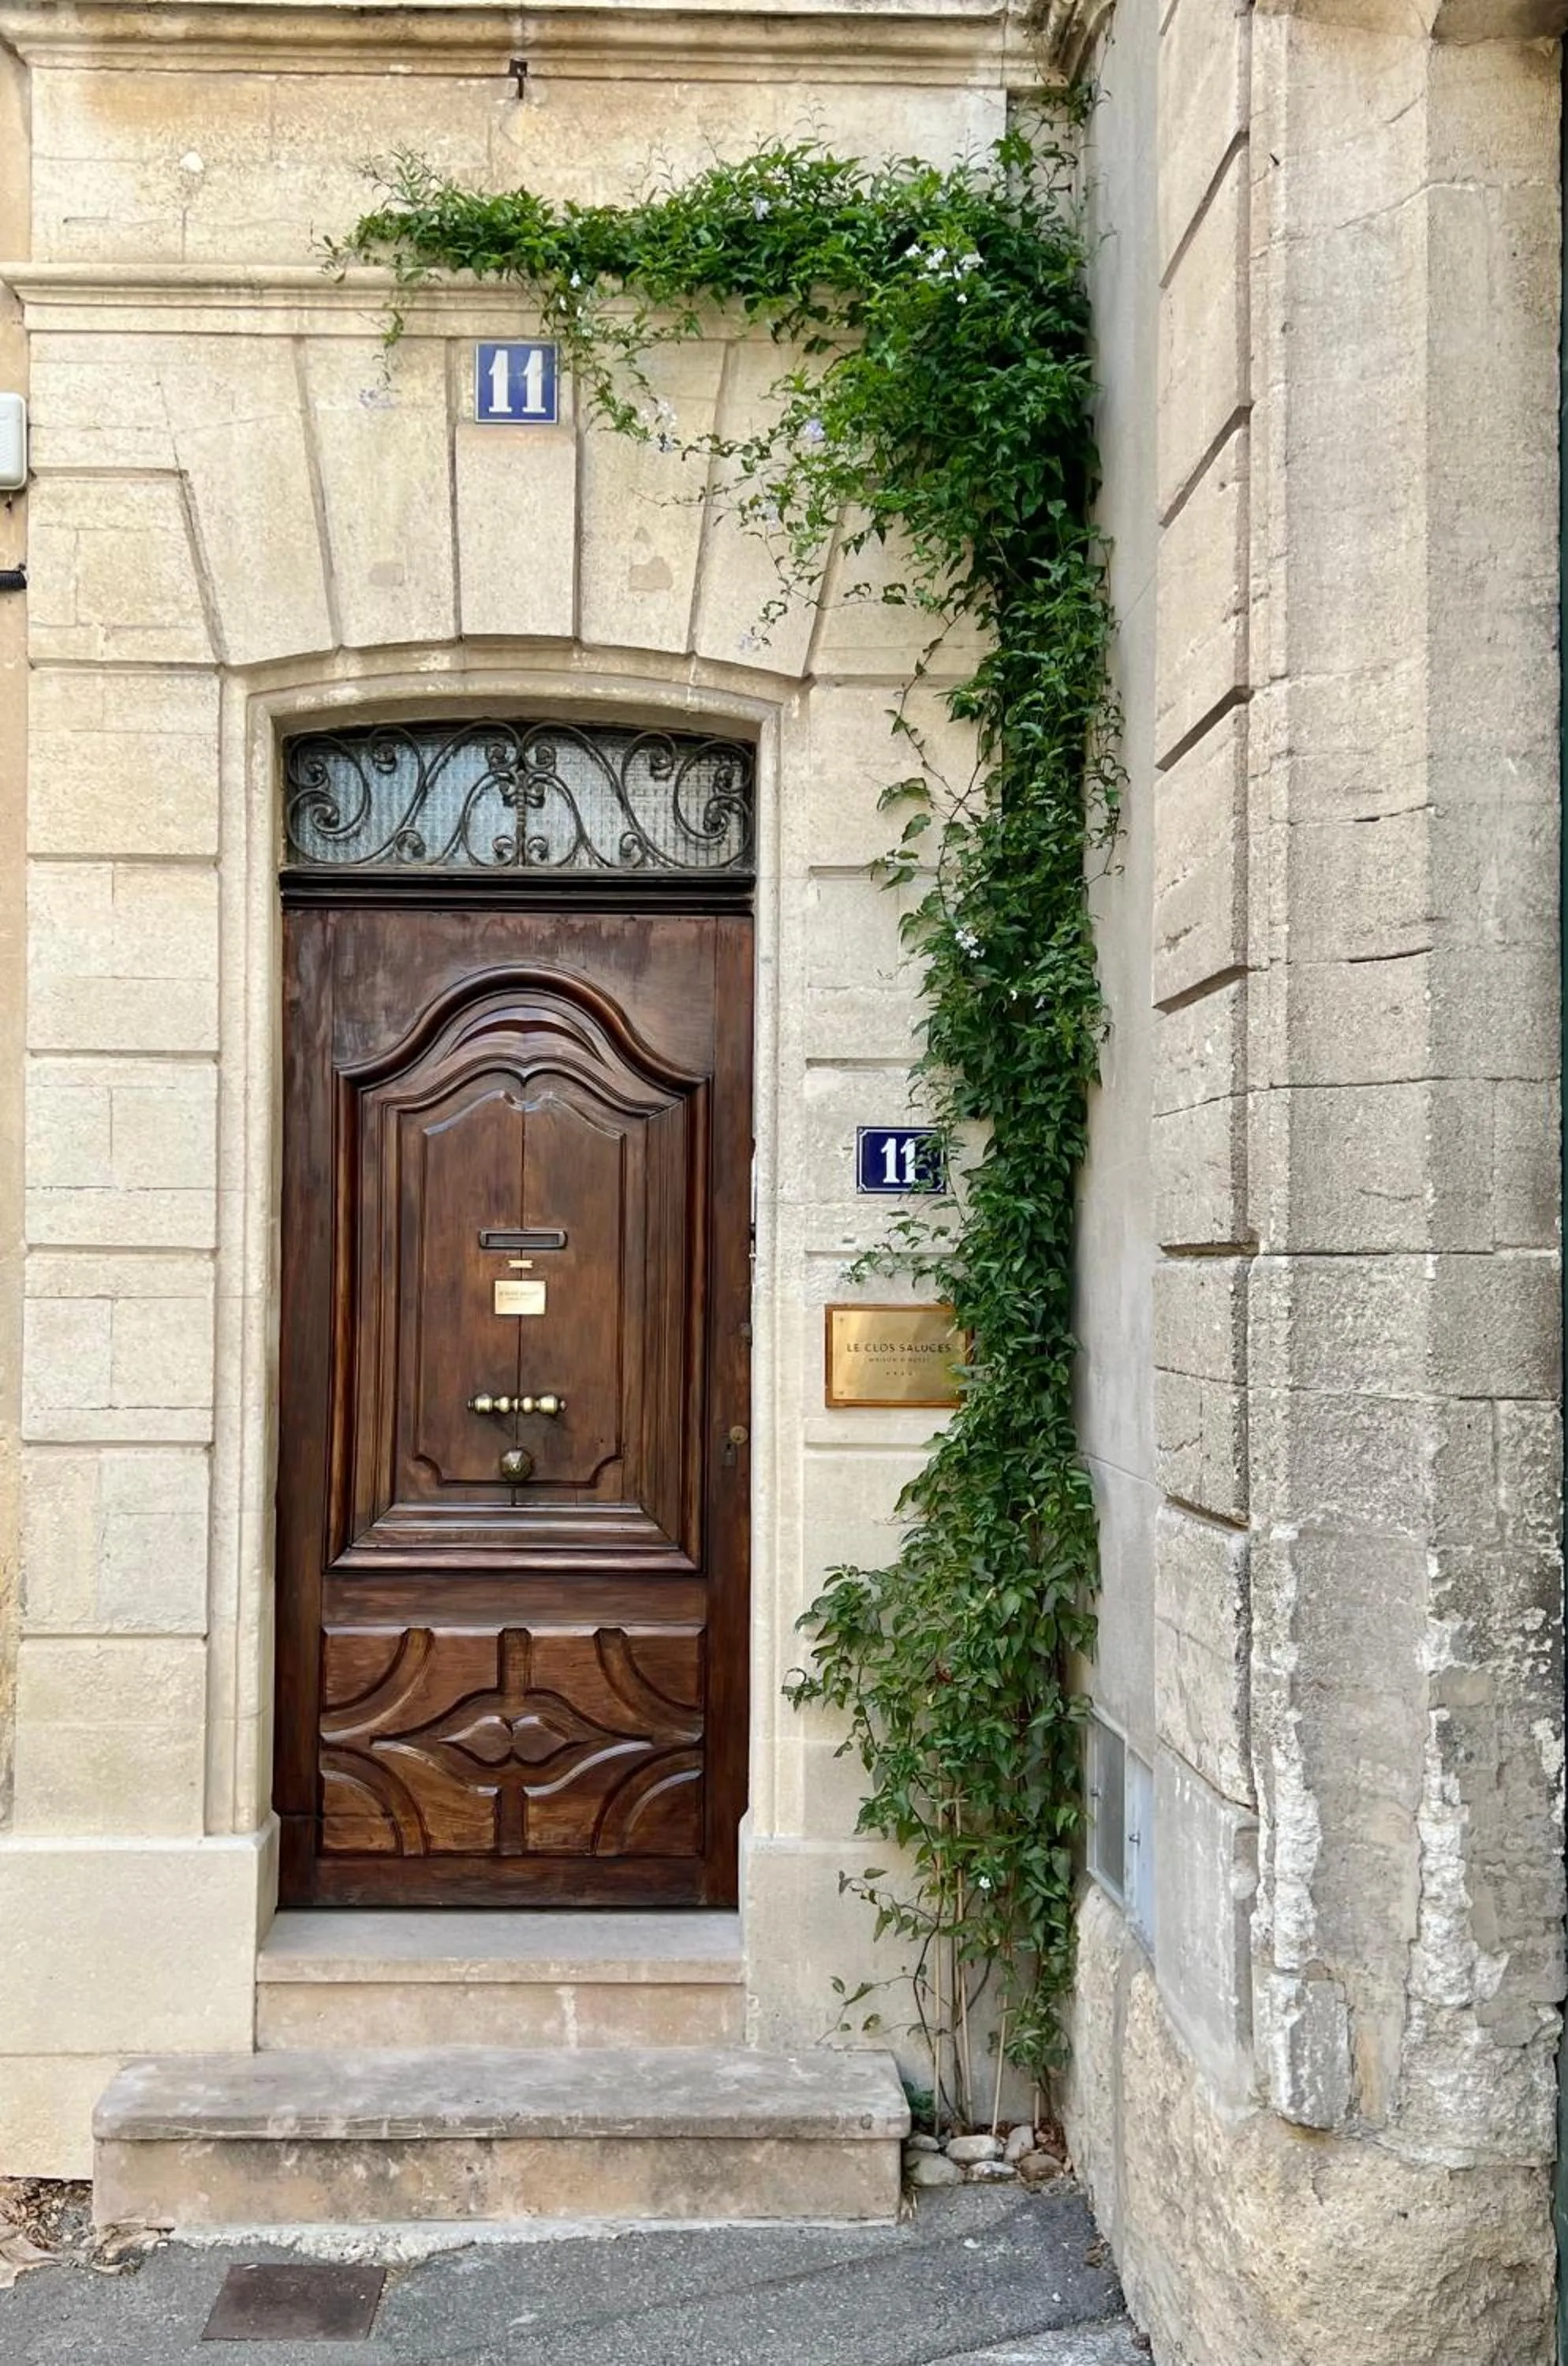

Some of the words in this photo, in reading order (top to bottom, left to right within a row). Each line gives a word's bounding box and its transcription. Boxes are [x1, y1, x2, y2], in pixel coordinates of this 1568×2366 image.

[488, 349, 547, 413] 11
[881, 1137, 920, 1183] 11
[846, 1343, 859, 1353] LE
[864, 1343, 895, 1353] CLOS
[899, 1343, 952, 1353] SALUCES
